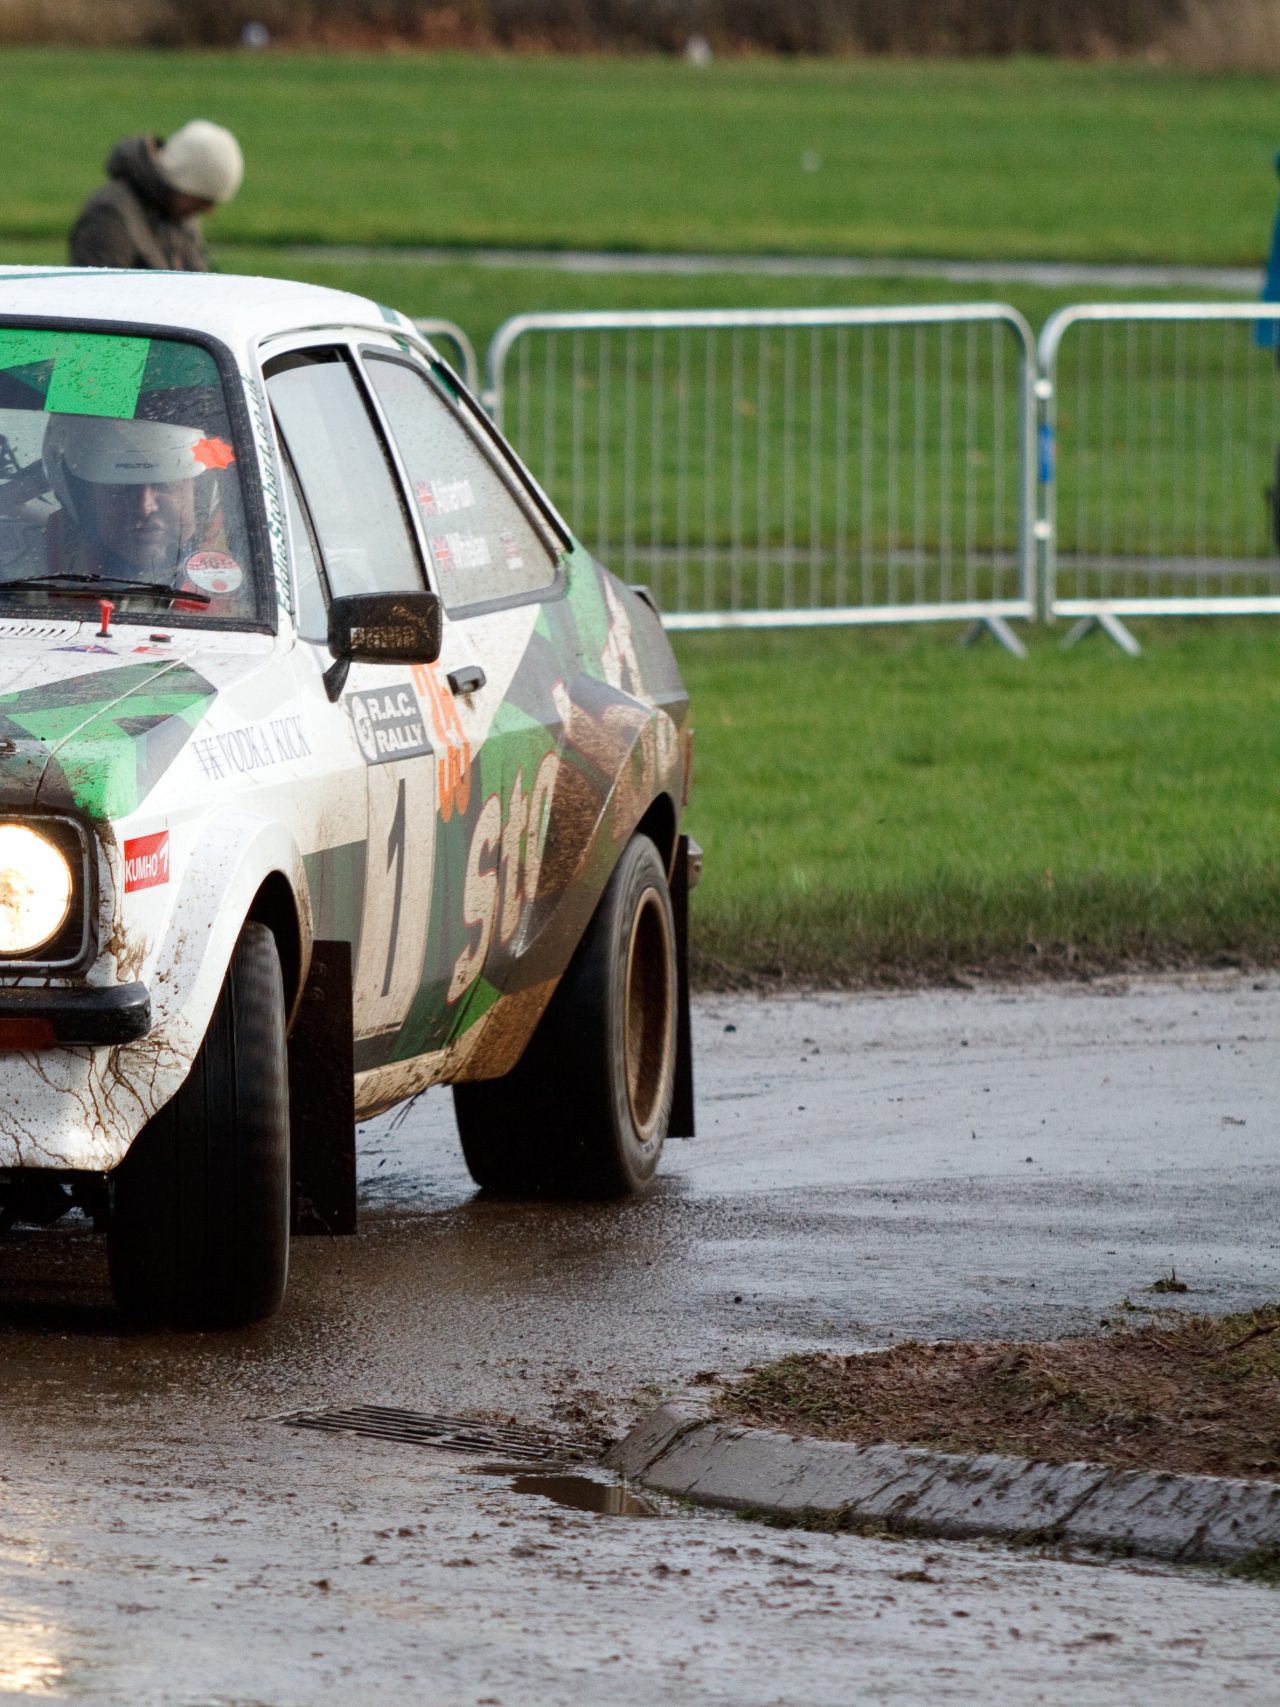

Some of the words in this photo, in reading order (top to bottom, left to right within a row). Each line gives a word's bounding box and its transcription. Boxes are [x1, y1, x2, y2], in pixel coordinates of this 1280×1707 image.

[366, 691, 417, 721] R.A.C.
[216, 726, 276, 772] VODKA
[270, 715, 313, 763] KICK
[375, 723, 424, 753] RALLY
[124, 853, 159, 883] KUMHO
[380, 778, 406, 998] 1
